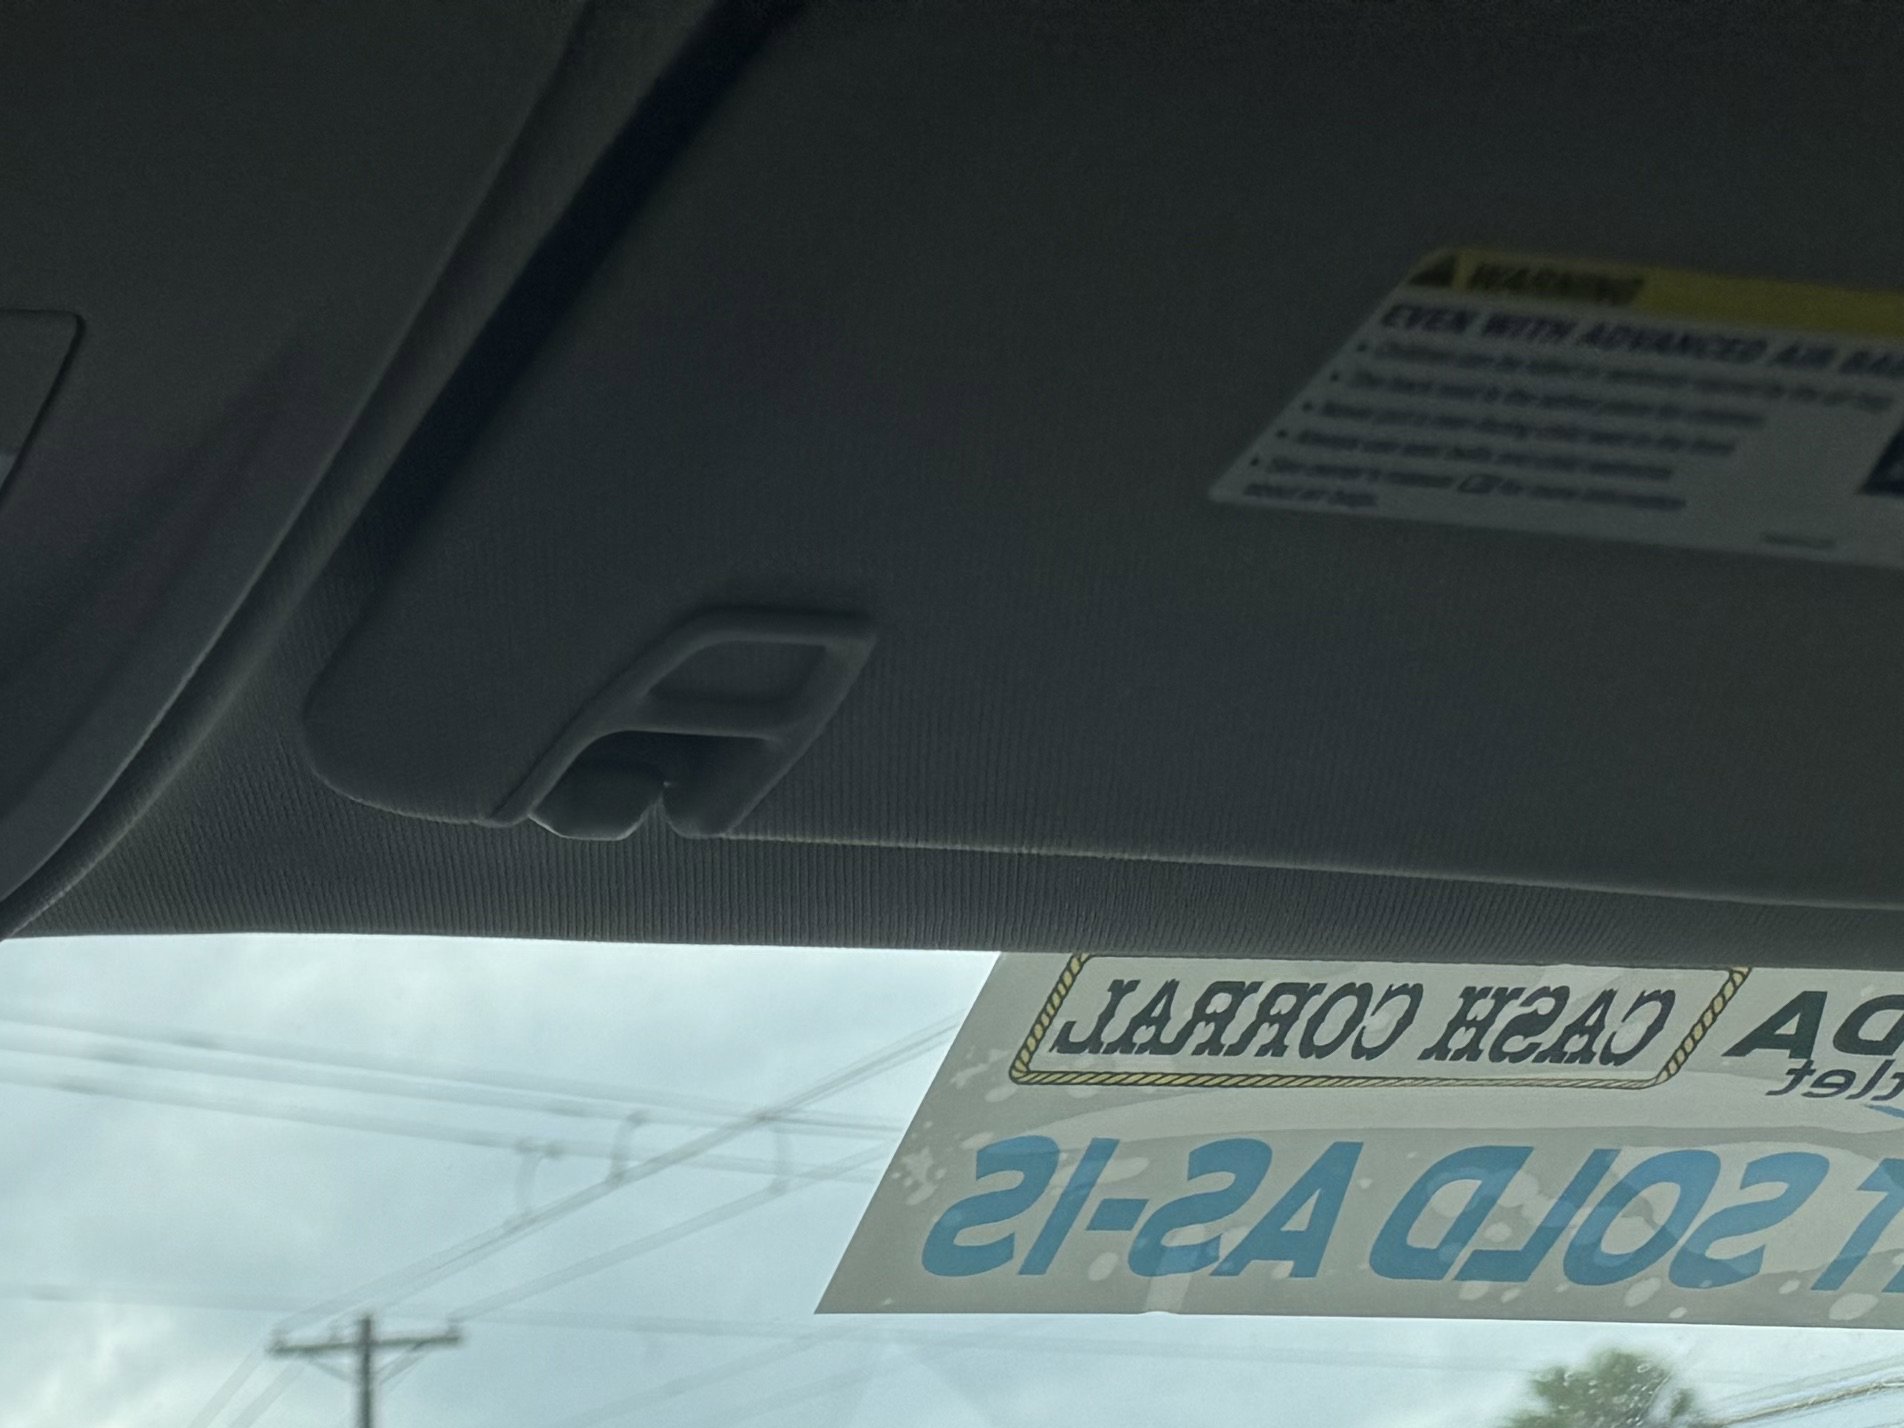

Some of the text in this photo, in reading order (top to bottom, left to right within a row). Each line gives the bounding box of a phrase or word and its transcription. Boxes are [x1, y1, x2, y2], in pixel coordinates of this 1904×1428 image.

[1381, 303, 1476, 337] EVEN
[1481, 312, 1575, 343] WITH
[1579, 321, 1768, 364] ADVANCED
[1768, 341, 1838, 369] AIR
